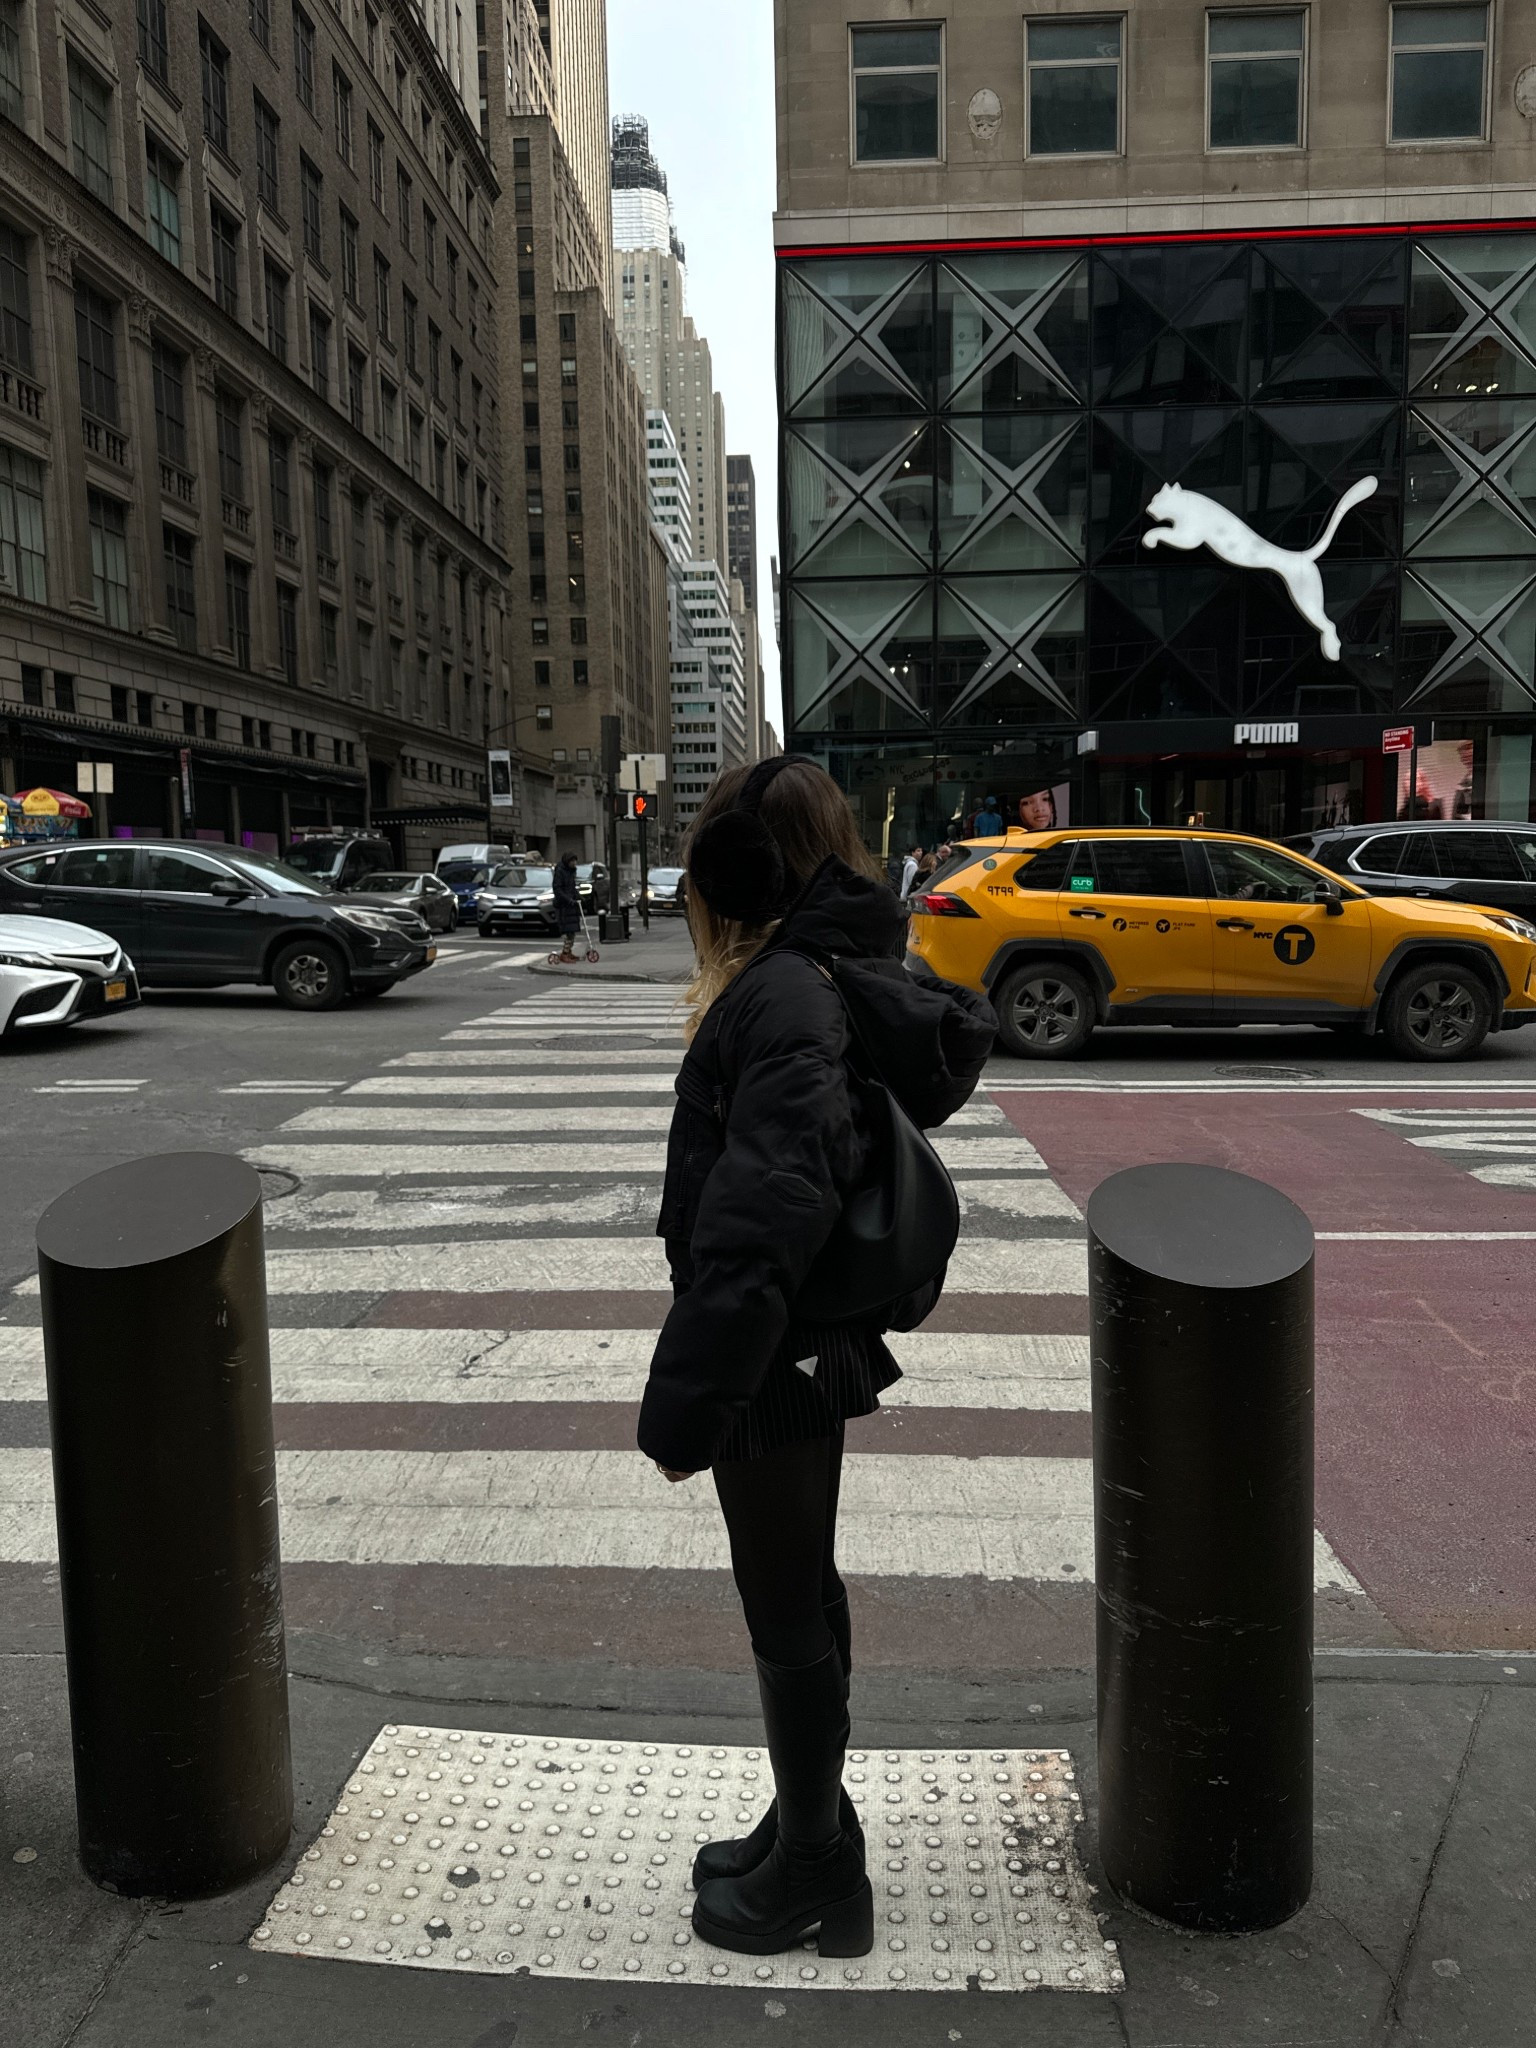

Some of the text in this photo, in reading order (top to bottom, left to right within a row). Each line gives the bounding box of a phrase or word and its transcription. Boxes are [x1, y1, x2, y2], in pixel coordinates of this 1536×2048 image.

[1234, 722, 1299, 744] PUMA
[1391, 729, 1409, 737] STANDING
[987, 885, 1014, 897] 9T99
[1283, 932, 1306, 960] T
